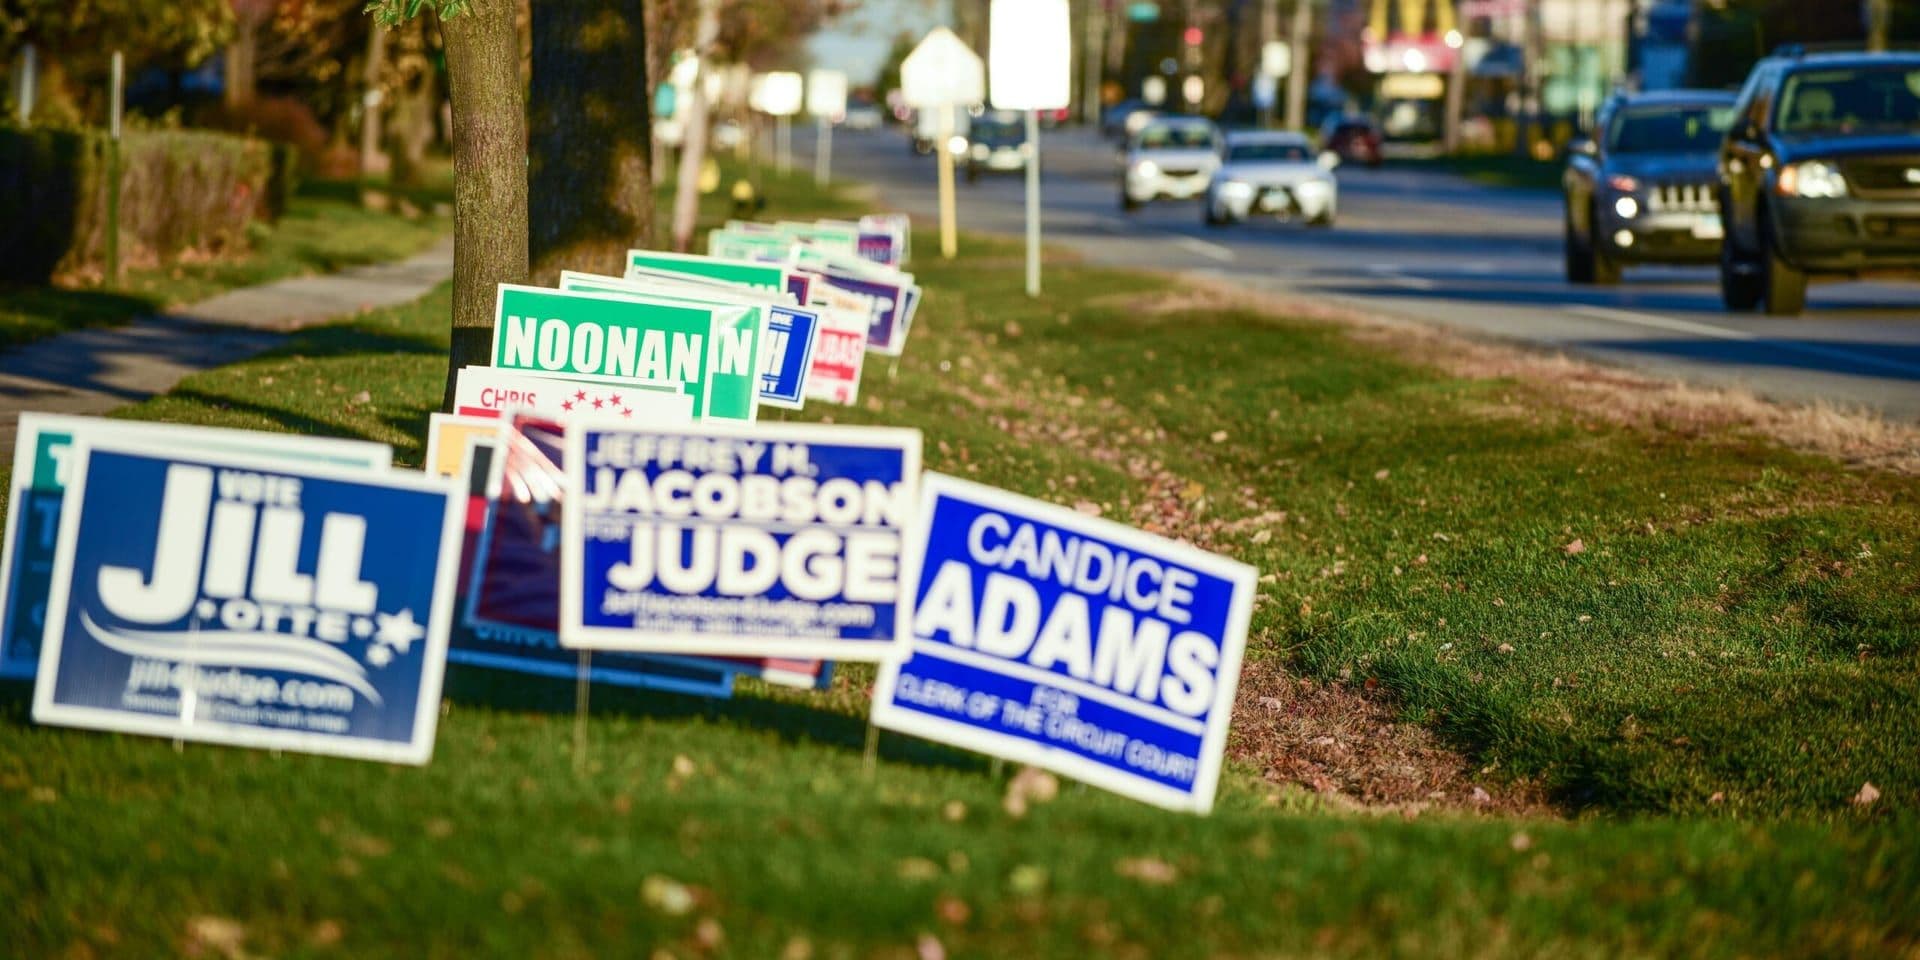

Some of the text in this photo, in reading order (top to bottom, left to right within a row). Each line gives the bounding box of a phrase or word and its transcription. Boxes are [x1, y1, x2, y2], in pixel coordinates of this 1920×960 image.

[503, 315, 703, 384] NOONAN
[219, 471, 304, 508] VOTE
[587, 432, 768, 475] JEFFREY
[584, 468, 904, 527] JACOBSON
[97, 463, 379, 624] JILL
[606, 520, 899, 602] JUDGE
[967, 511, 1199, 625] CANDICE
[913, 558, 1221, 718] ADAMS
[896, 673, 1198, 782] CLERK OF THE CIRCUIT COURT
